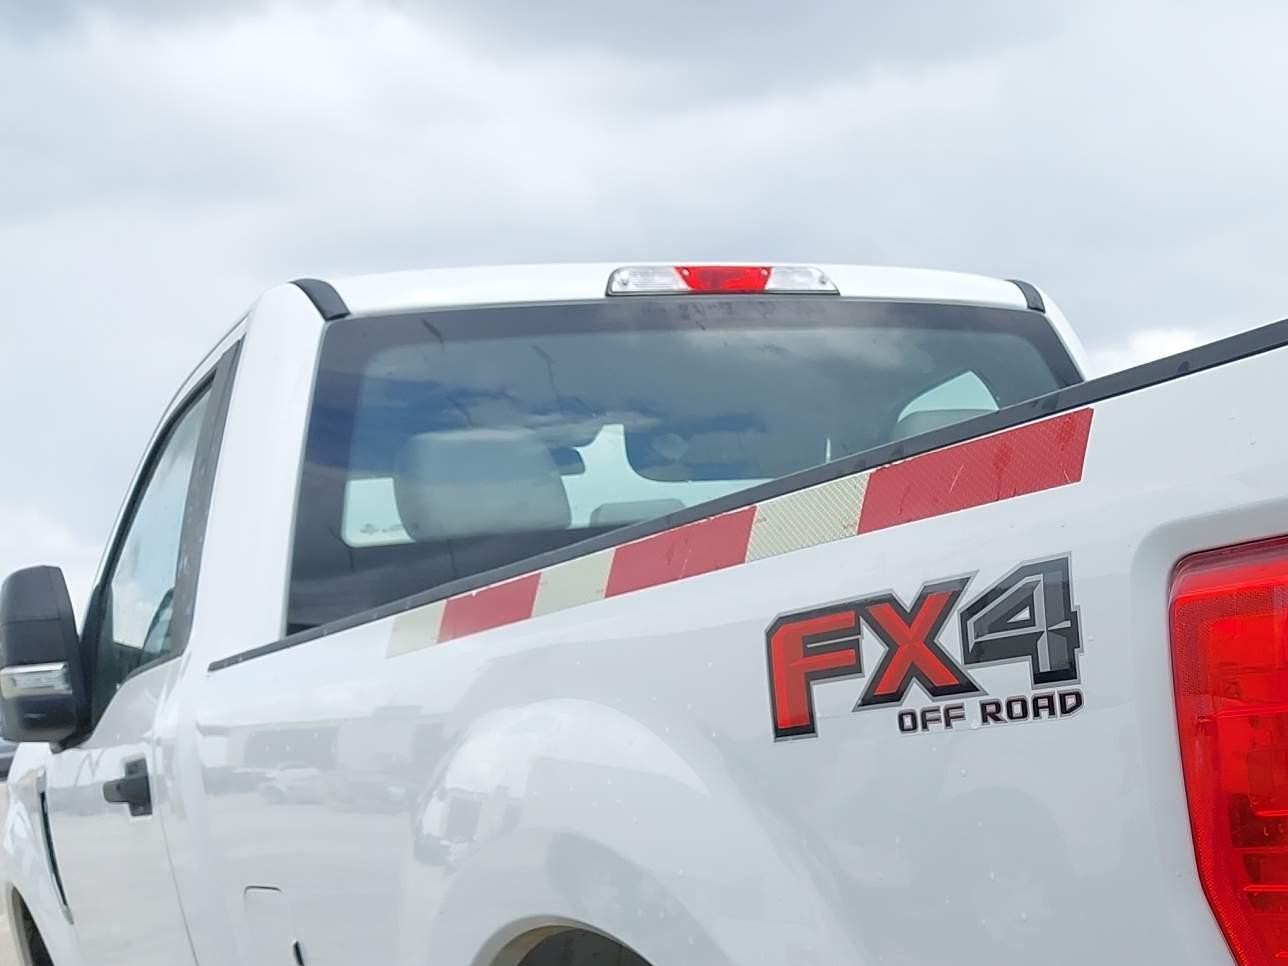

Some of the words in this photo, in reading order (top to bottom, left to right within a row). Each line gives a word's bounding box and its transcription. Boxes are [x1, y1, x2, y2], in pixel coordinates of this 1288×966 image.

[765, 551, 1084, 743] FX4
[899, 702, 966, 734] OFF
[979, 688, 1085, 725] ROAD
